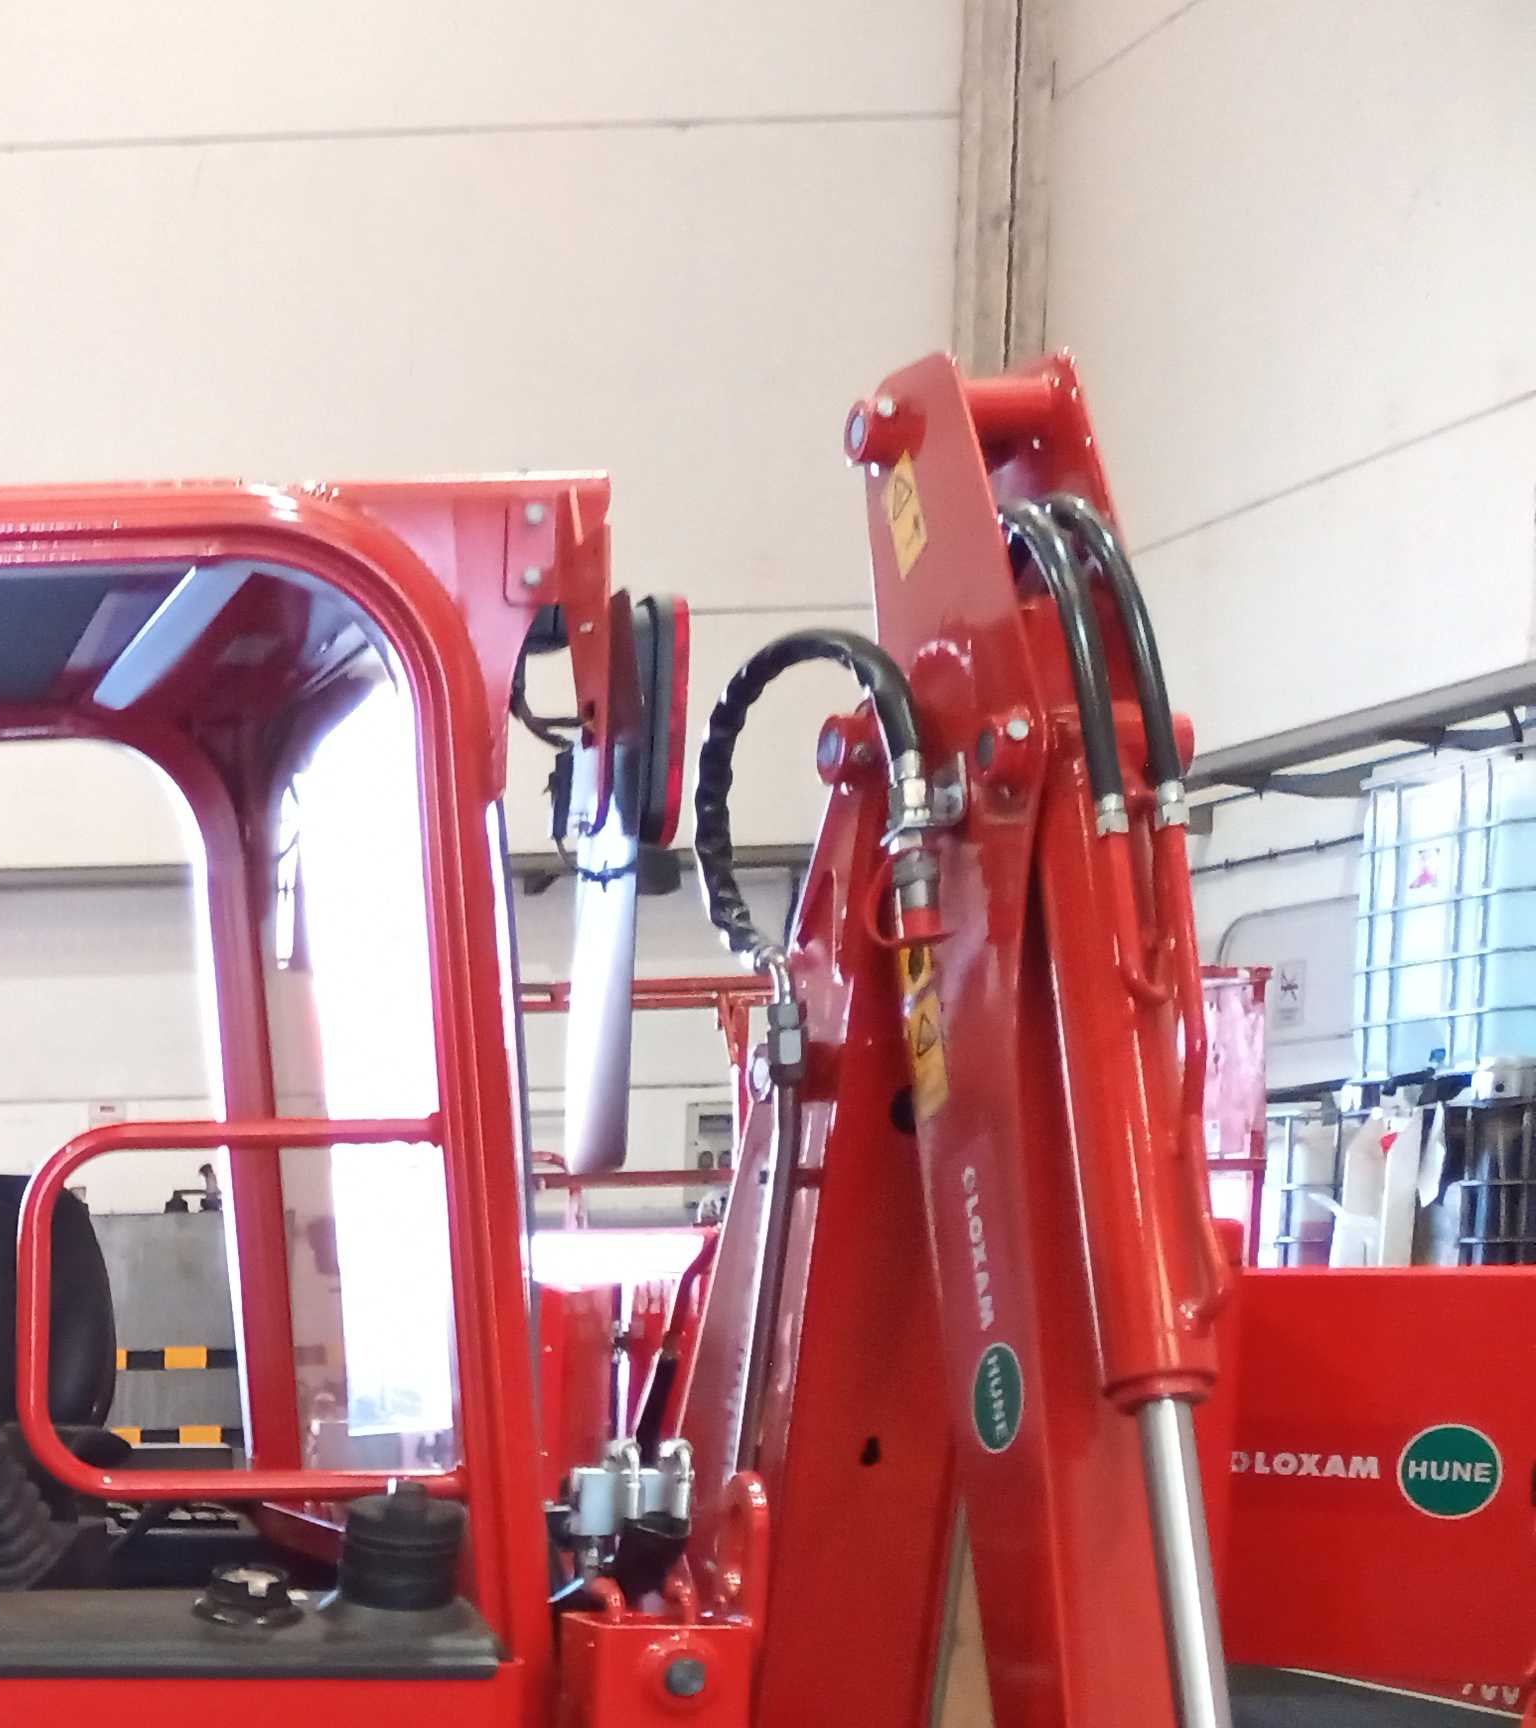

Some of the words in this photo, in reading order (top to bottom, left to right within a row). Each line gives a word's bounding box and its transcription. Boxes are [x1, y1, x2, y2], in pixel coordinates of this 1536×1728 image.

[964, 1195, 996, 1331] LOXAM
[987, 1354, 1009, 1443] HUNE
[1254, 1451, 1380, 1480] LOXAM
[1408, 1459, 1493, 1483] HUNE
